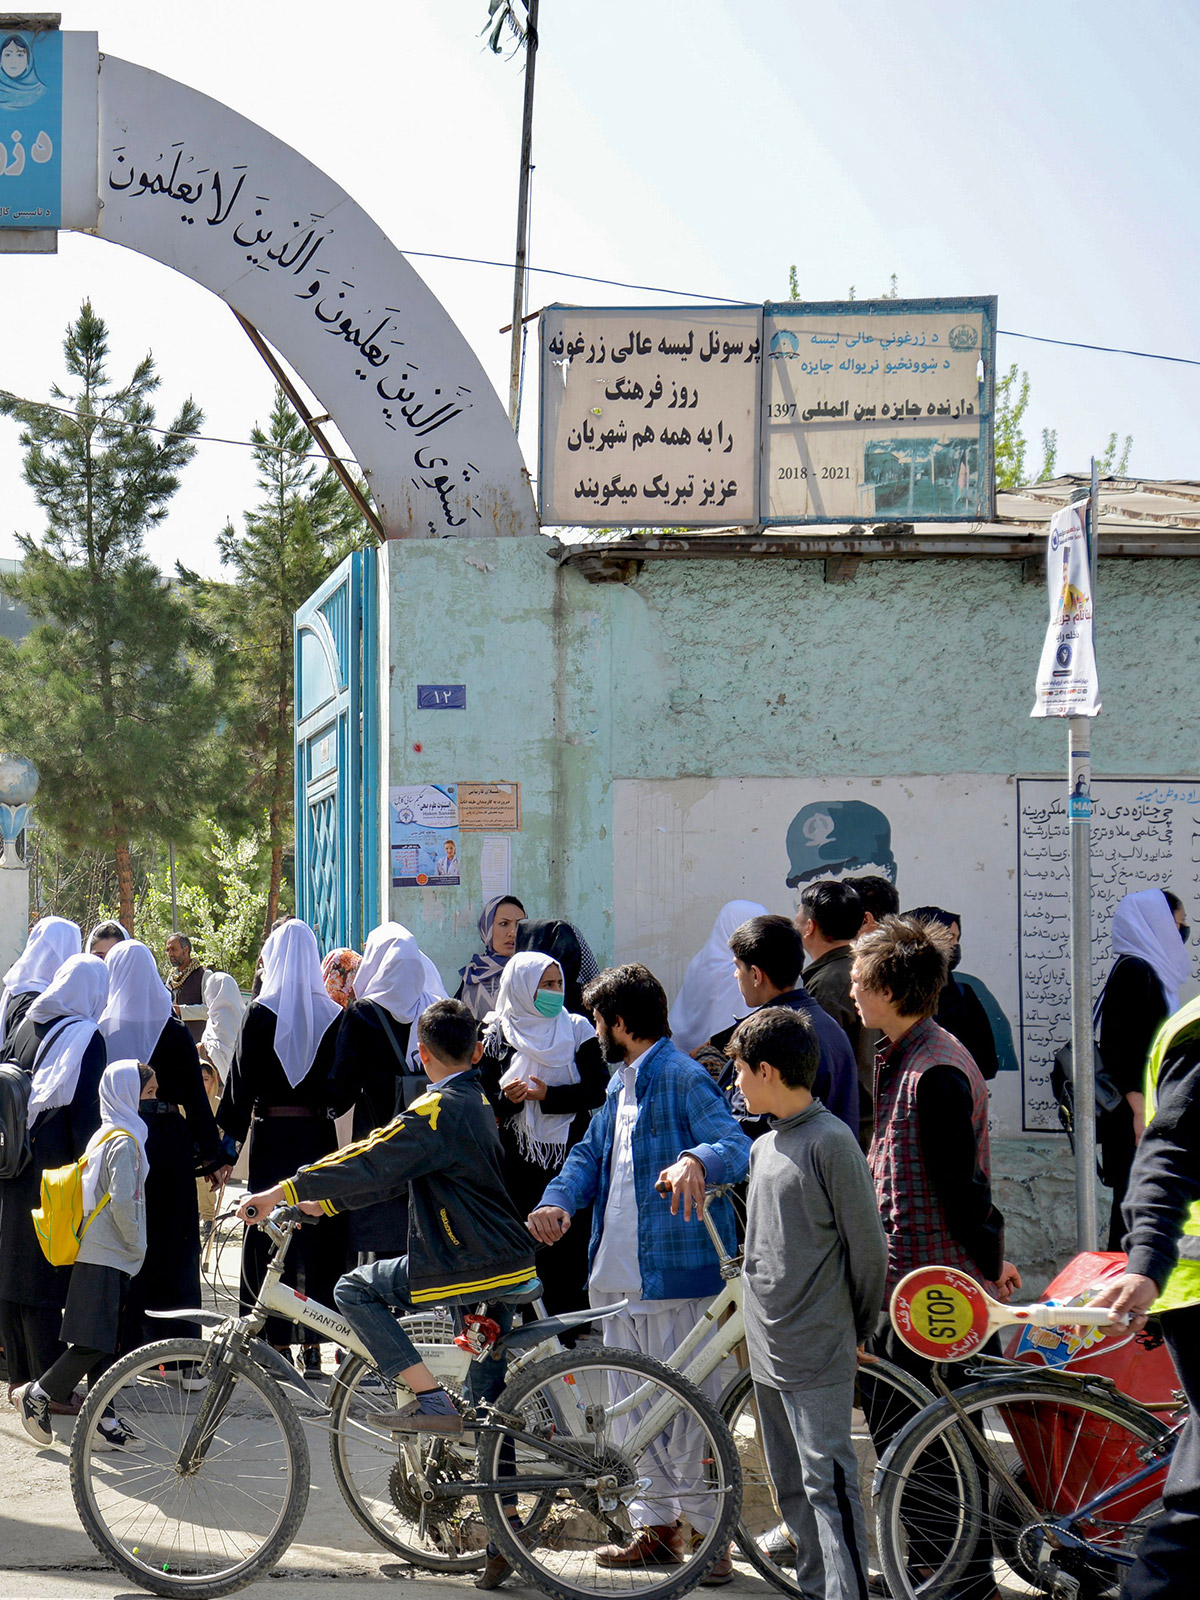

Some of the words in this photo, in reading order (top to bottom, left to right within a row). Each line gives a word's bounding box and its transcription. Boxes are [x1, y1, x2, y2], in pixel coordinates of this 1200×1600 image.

[31, 131, 53, 163] د
[549, 330, 606, 364] زرغونه
[657, 330, 694, 361] لیسه
[810, 332, 840, 349] لیسه
[931, 334, 939, 343] د
[801, 358, 834, 375] جایزه
[943, 358, 951, 369] د
[604, 373, 663, 408] فرهنگ
[667, 380, 699, 408] روز
[766, 403, 798, 418] 1397
[853, 402, 877, 421] بین
[881, 400, 923, 420] جایزه
[927, 398, 975, 419] دارنده
[567, 419, 628, 452] شهریان
[632, 425, 655, 451] هم
[659, 425, 691, 446] همه
[697, 426, 713, 452] به
[718, 420, 734, 453] را
[777, 466, 809, 480] 2018
[821, 466, 851, 480] 2021
[574, 473, 638, 506] میگویند
[642, 474, 694, 506] تبریک
[698, 479, 738, 506] عزیز
[302, 1307, 351, 1337] PHANTOM
[927, 1289, 957, 1339] STOP
